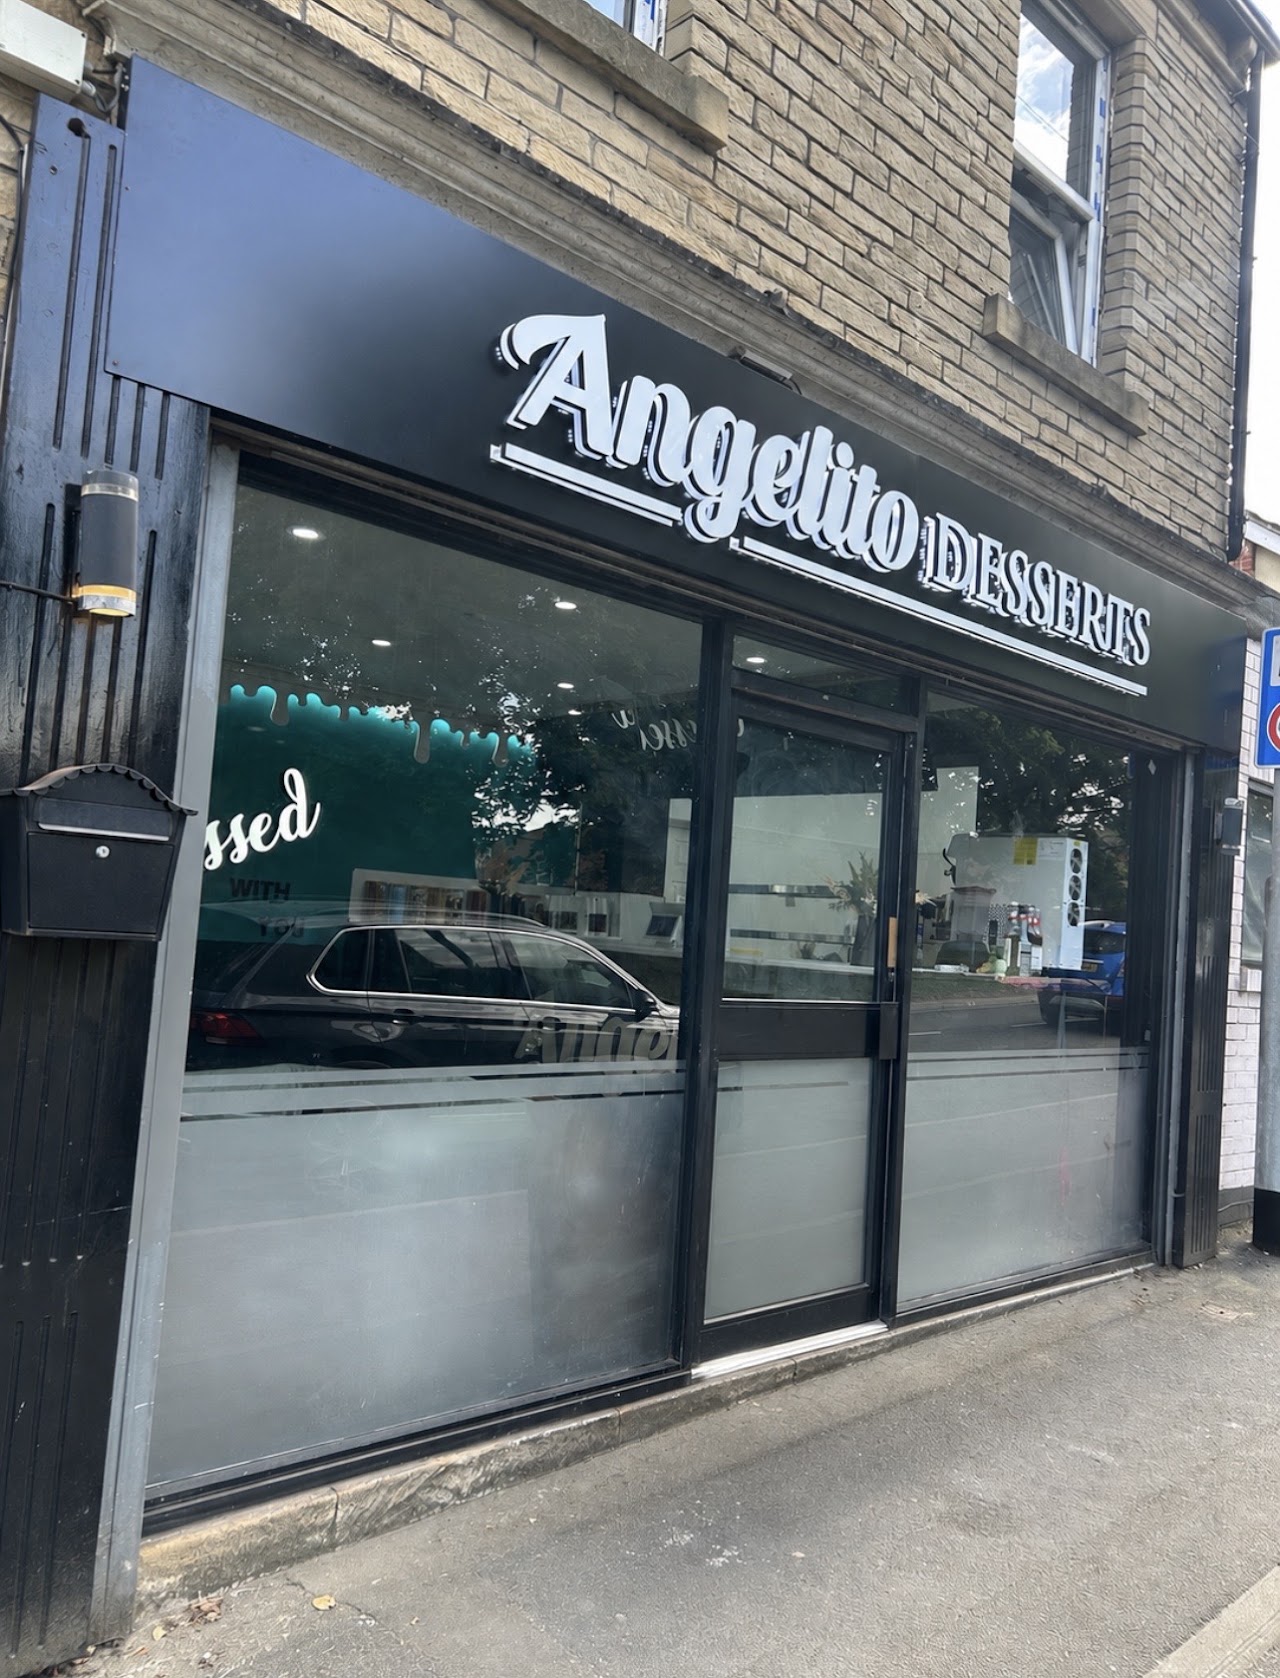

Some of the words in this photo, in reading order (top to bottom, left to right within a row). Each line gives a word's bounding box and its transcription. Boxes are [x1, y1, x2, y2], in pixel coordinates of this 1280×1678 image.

[496, 313, 921, 572] Angelito
[921, 511, 1152, 667] DESSERTS
[230, 877, 291, 901] WITH
